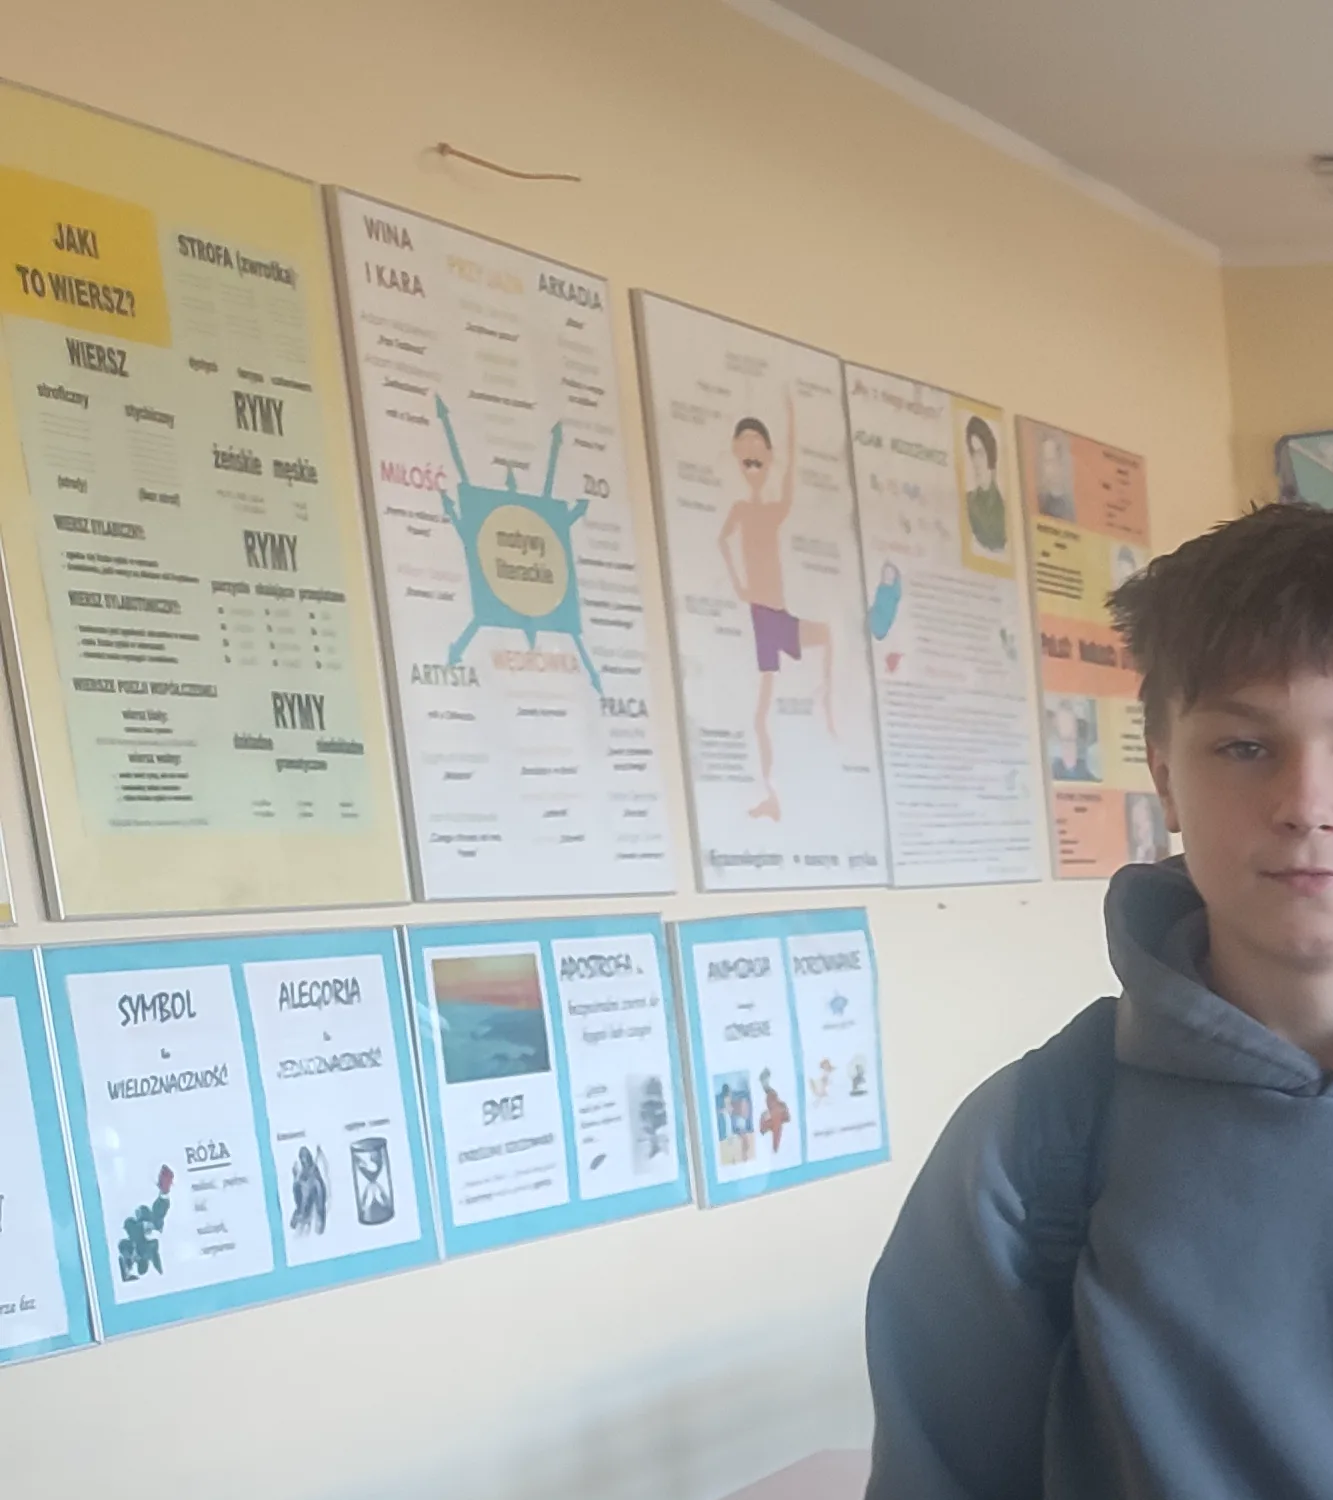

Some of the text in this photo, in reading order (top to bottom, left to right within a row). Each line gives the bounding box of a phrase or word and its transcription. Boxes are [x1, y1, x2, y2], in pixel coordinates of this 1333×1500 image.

[53, 222, 100, 260] JAKI
[176, 233, 234, 269] STROFA
[364, 215, 414, 251] WINA
[16, 263, 137, 318] TO WIERSZ?
[376, 263, 426, 298] KARA
[65, 336, 130, 378] WIERSZ
[233, 390, 284, 436] RYMY
[379, 458, 448, 493] MIŁOŚĆ
[243, 529, 298, 573] RYMY
[410, 662, 481, 689] ARTYSTA
[271, 690, 326, 732] RYMY
[117, 989, 197, 1027] SYMBOL
[278, 976, 362, 1013] ALEGORIA
[107, 1063, 229, 1102] WIELOZNACZNOŚĆ
[185, 1139, 231, 1166] RÓŻA
